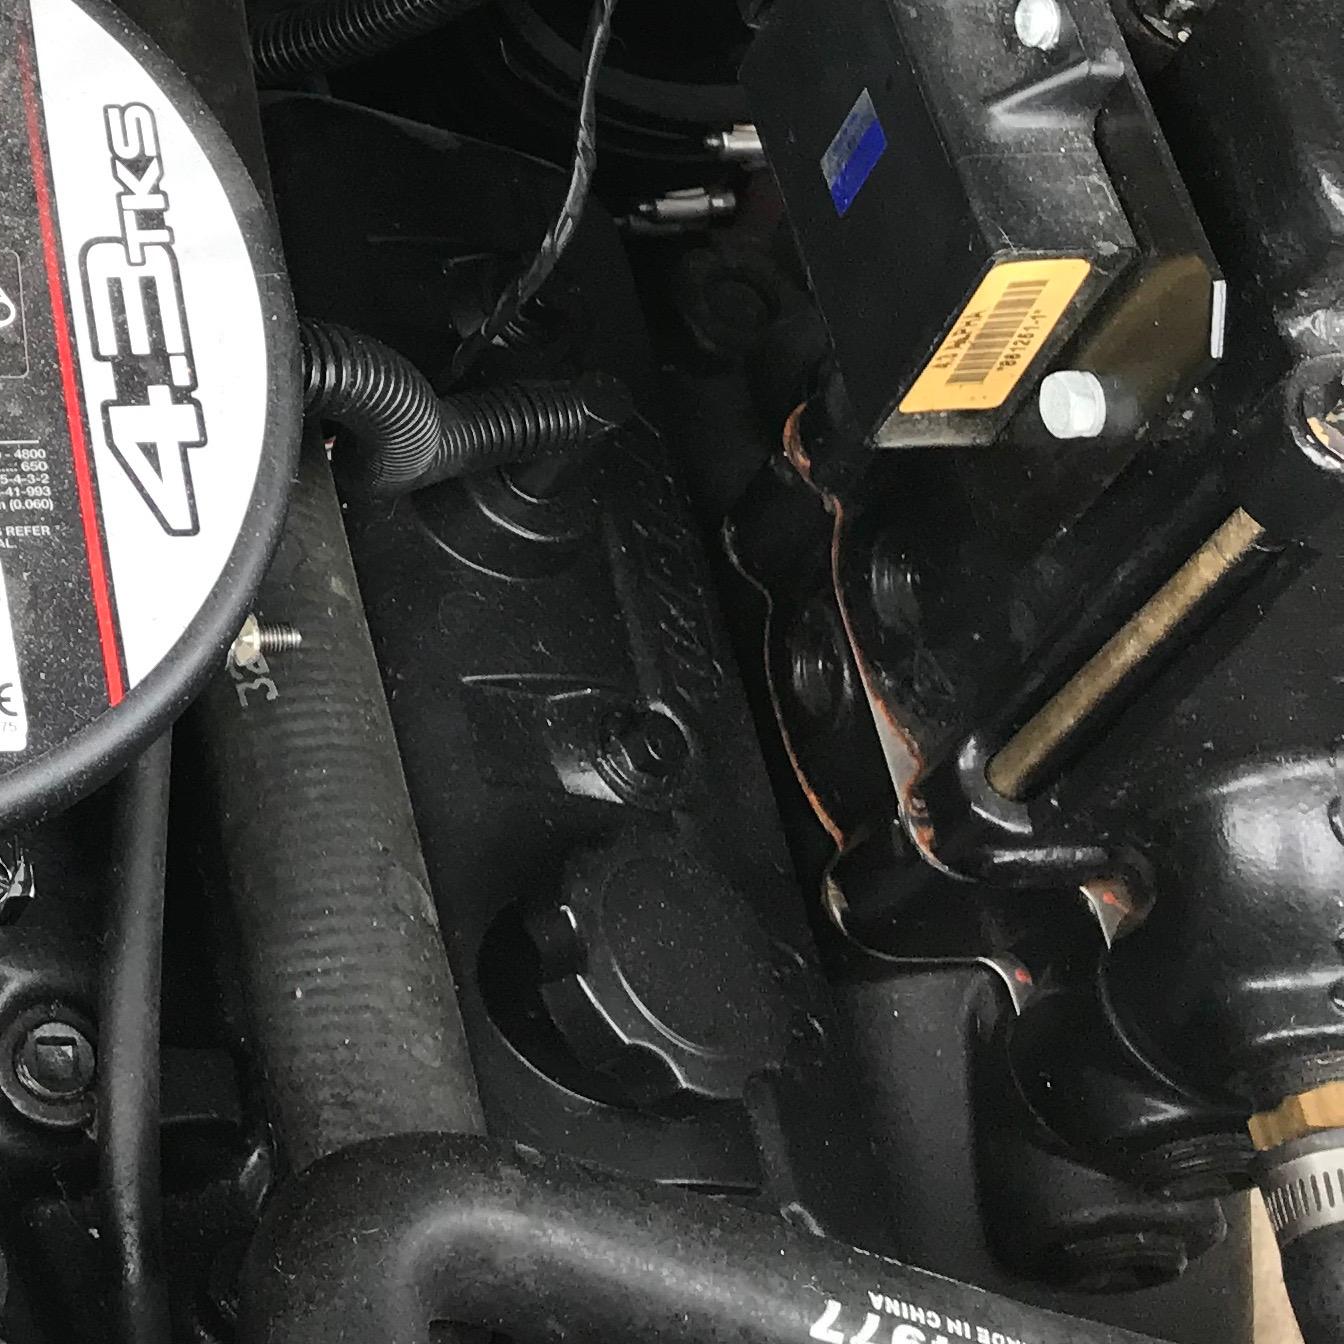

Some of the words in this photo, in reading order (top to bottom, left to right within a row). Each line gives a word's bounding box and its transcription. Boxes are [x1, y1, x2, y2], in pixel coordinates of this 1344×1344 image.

[13, 448, 46, 459] 4800
[21, 462, 48, 472] 650
[9, 498, 54, 511] (0.060)
[6, 525, 50, 536] REFER
[867, 1290, 942, 1329] CHINA
[946, 1316, 972, 1340] IN
